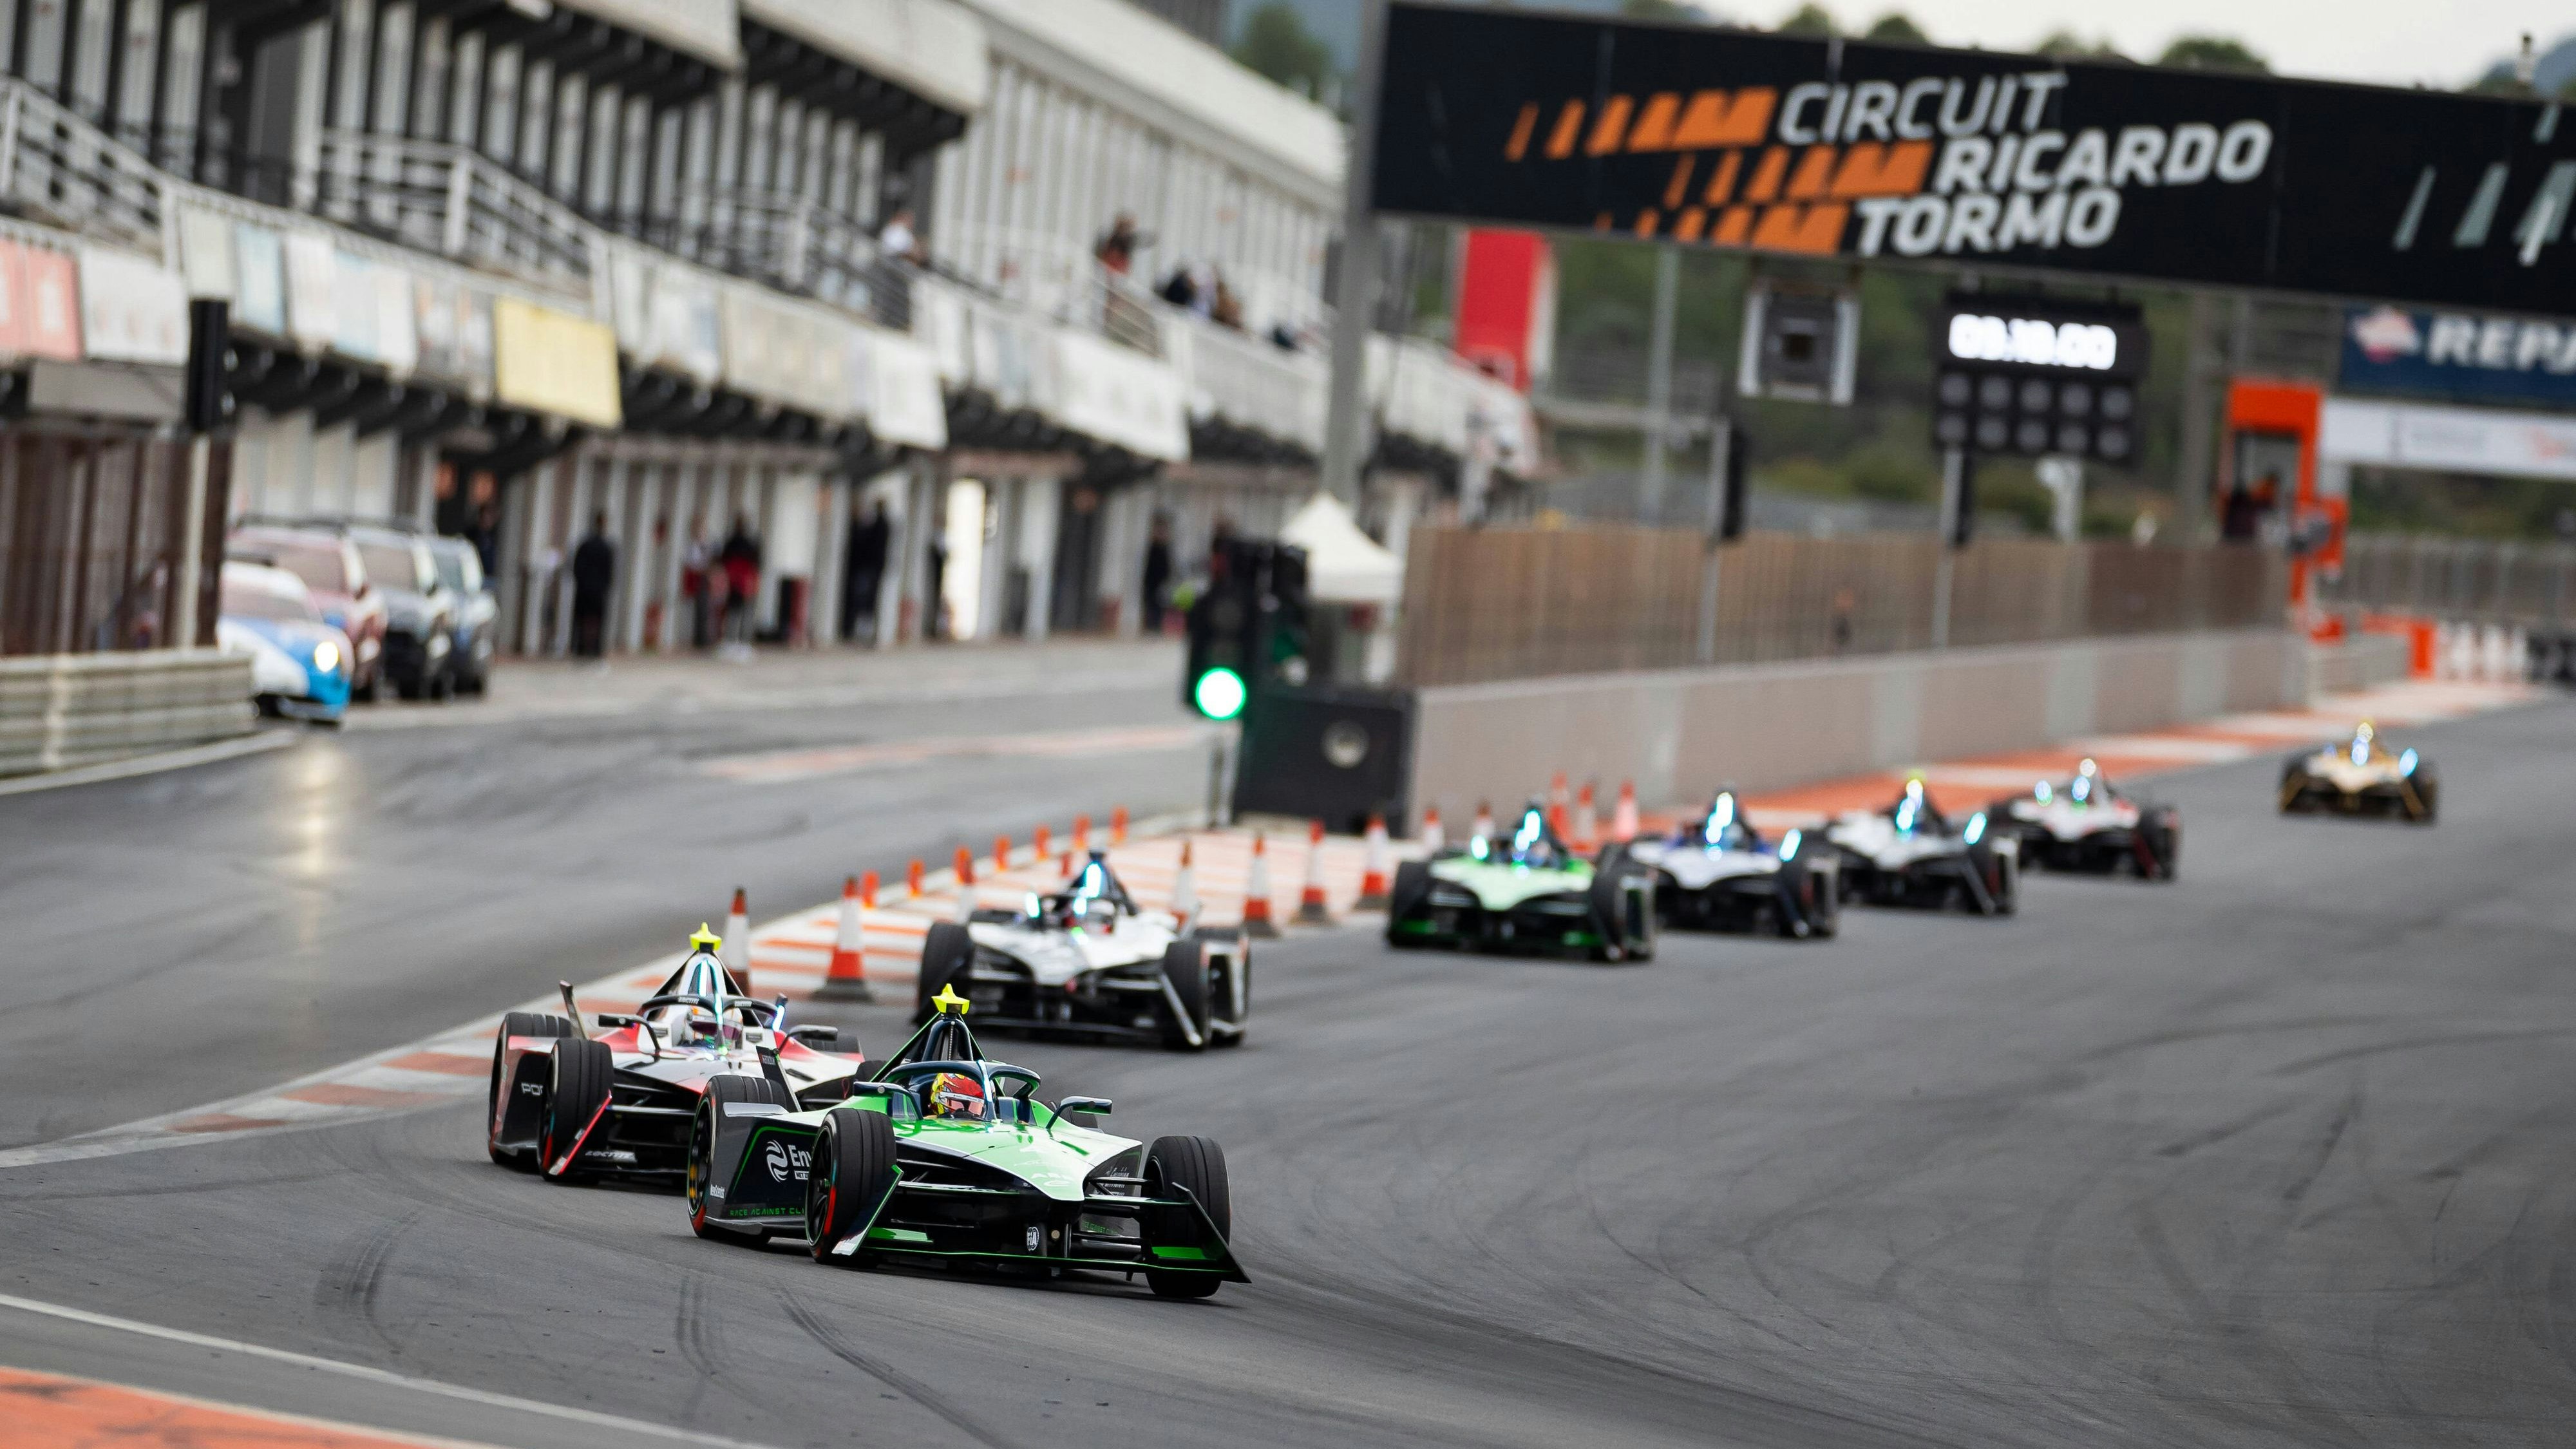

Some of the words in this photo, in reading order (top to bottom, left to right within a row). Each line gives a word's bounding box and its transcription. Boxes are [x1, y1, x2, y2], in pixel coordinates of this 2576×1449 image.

[1777, 72, 2069, 144] CIRCUIT
[1935, 120, 2273, 195] RICARDO
[1856, 188, 2121, 257] TORMO
